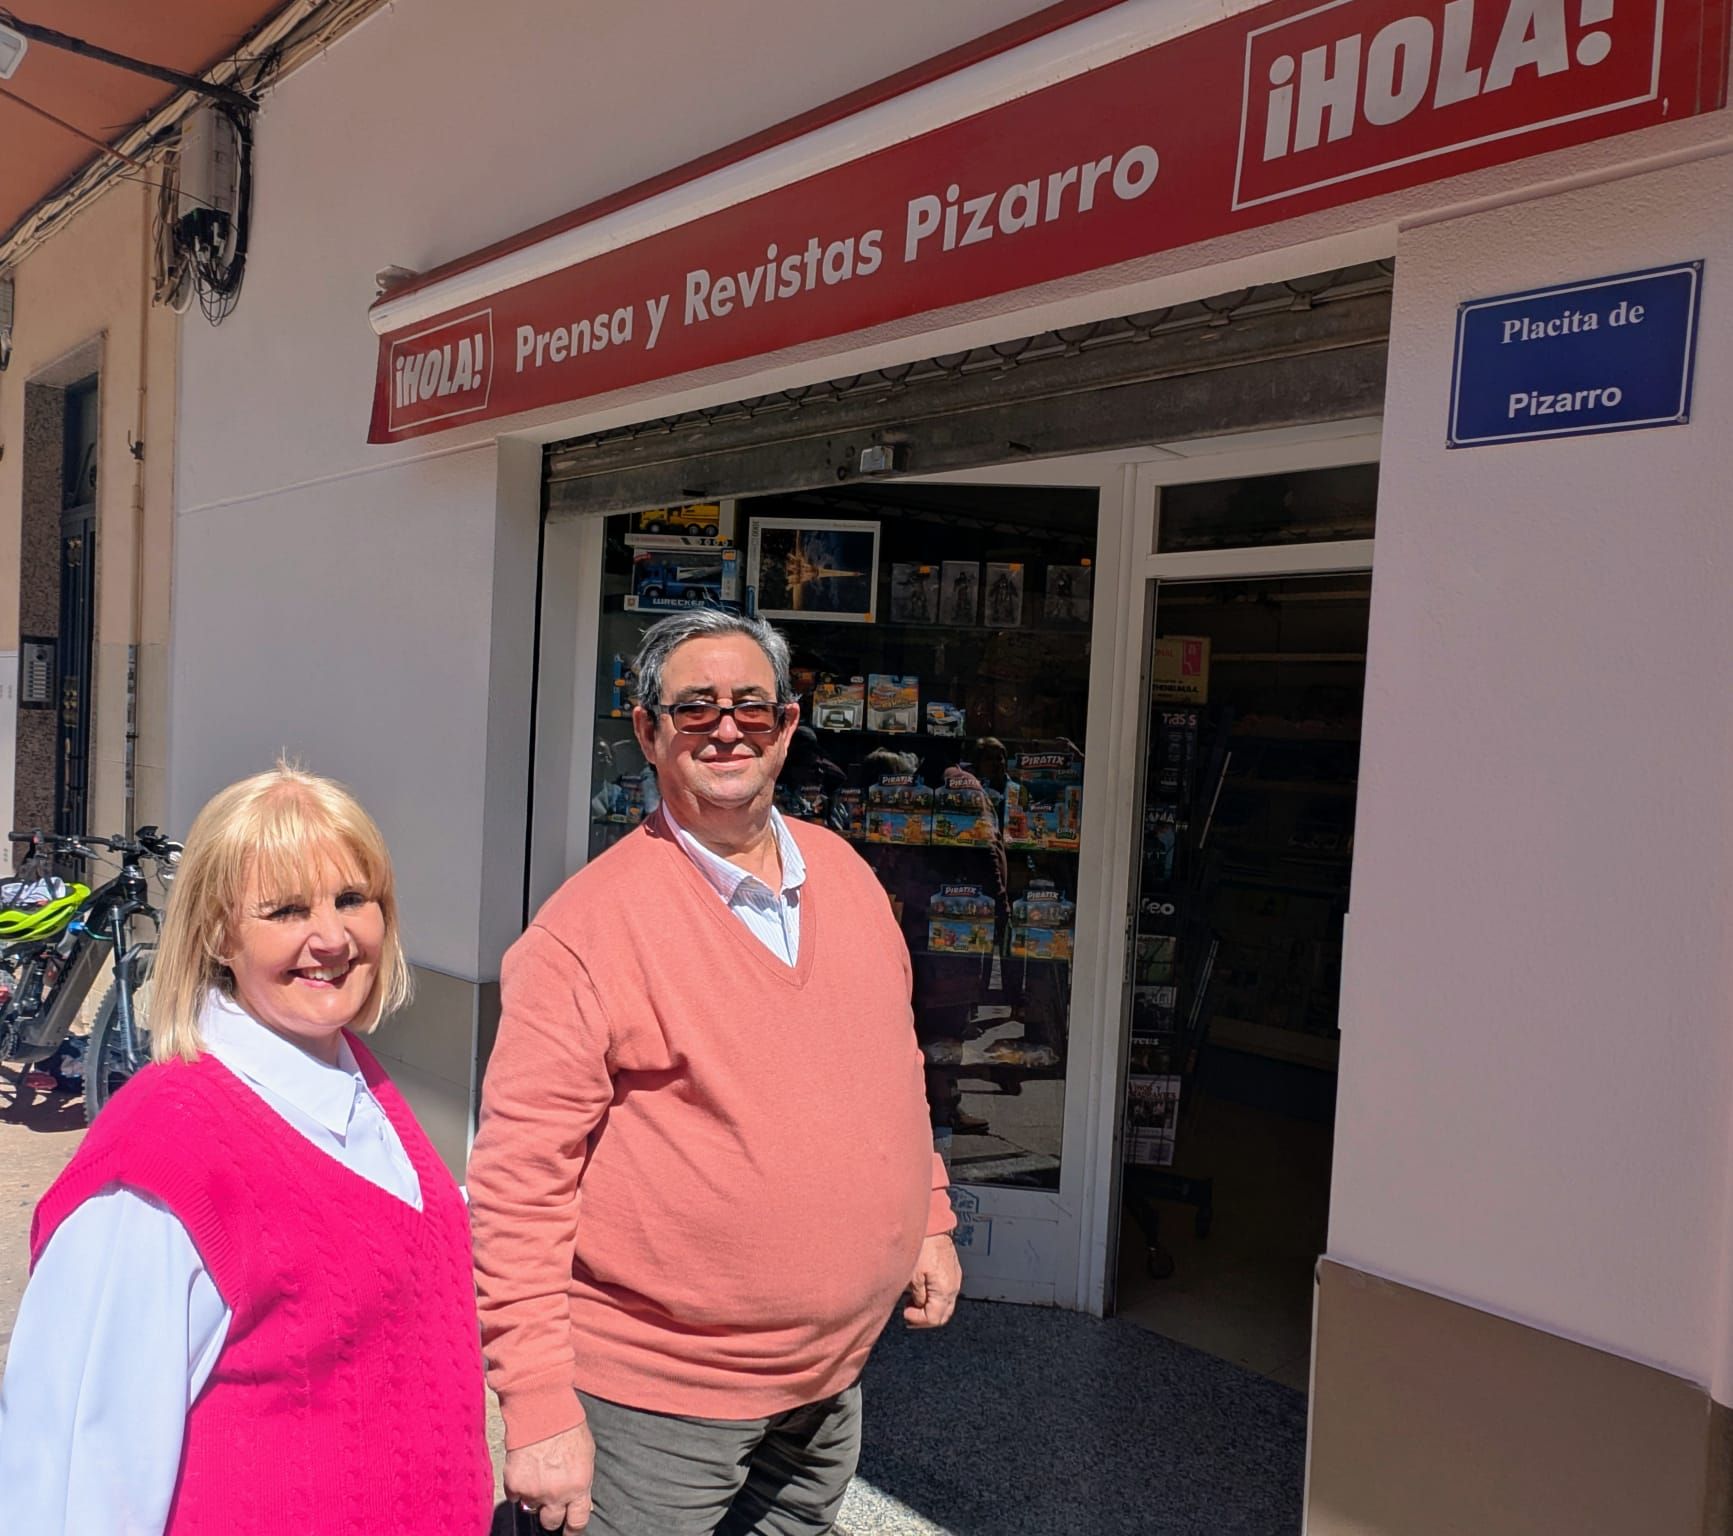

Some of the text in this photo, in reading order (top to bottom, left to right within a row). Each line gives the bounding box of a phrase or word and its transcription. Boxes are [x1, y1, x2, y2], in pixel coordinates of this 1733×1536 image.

[1263, 0, 1614, 162] ¡HOLA!
[516, 145, 1159, 373] Prensa y Revistas Pizarro
[1500, 301, 1646, 344] Placita de
[395, 332, 485, 409] ¡HOLA!
[1507, 386, 1623, 419] Pizarro
[652, 597, 706, 607] WRECKER
[1020, 754, 1066, 767] PIRATIX
[881, 775, 914, 785] PIRATIX
